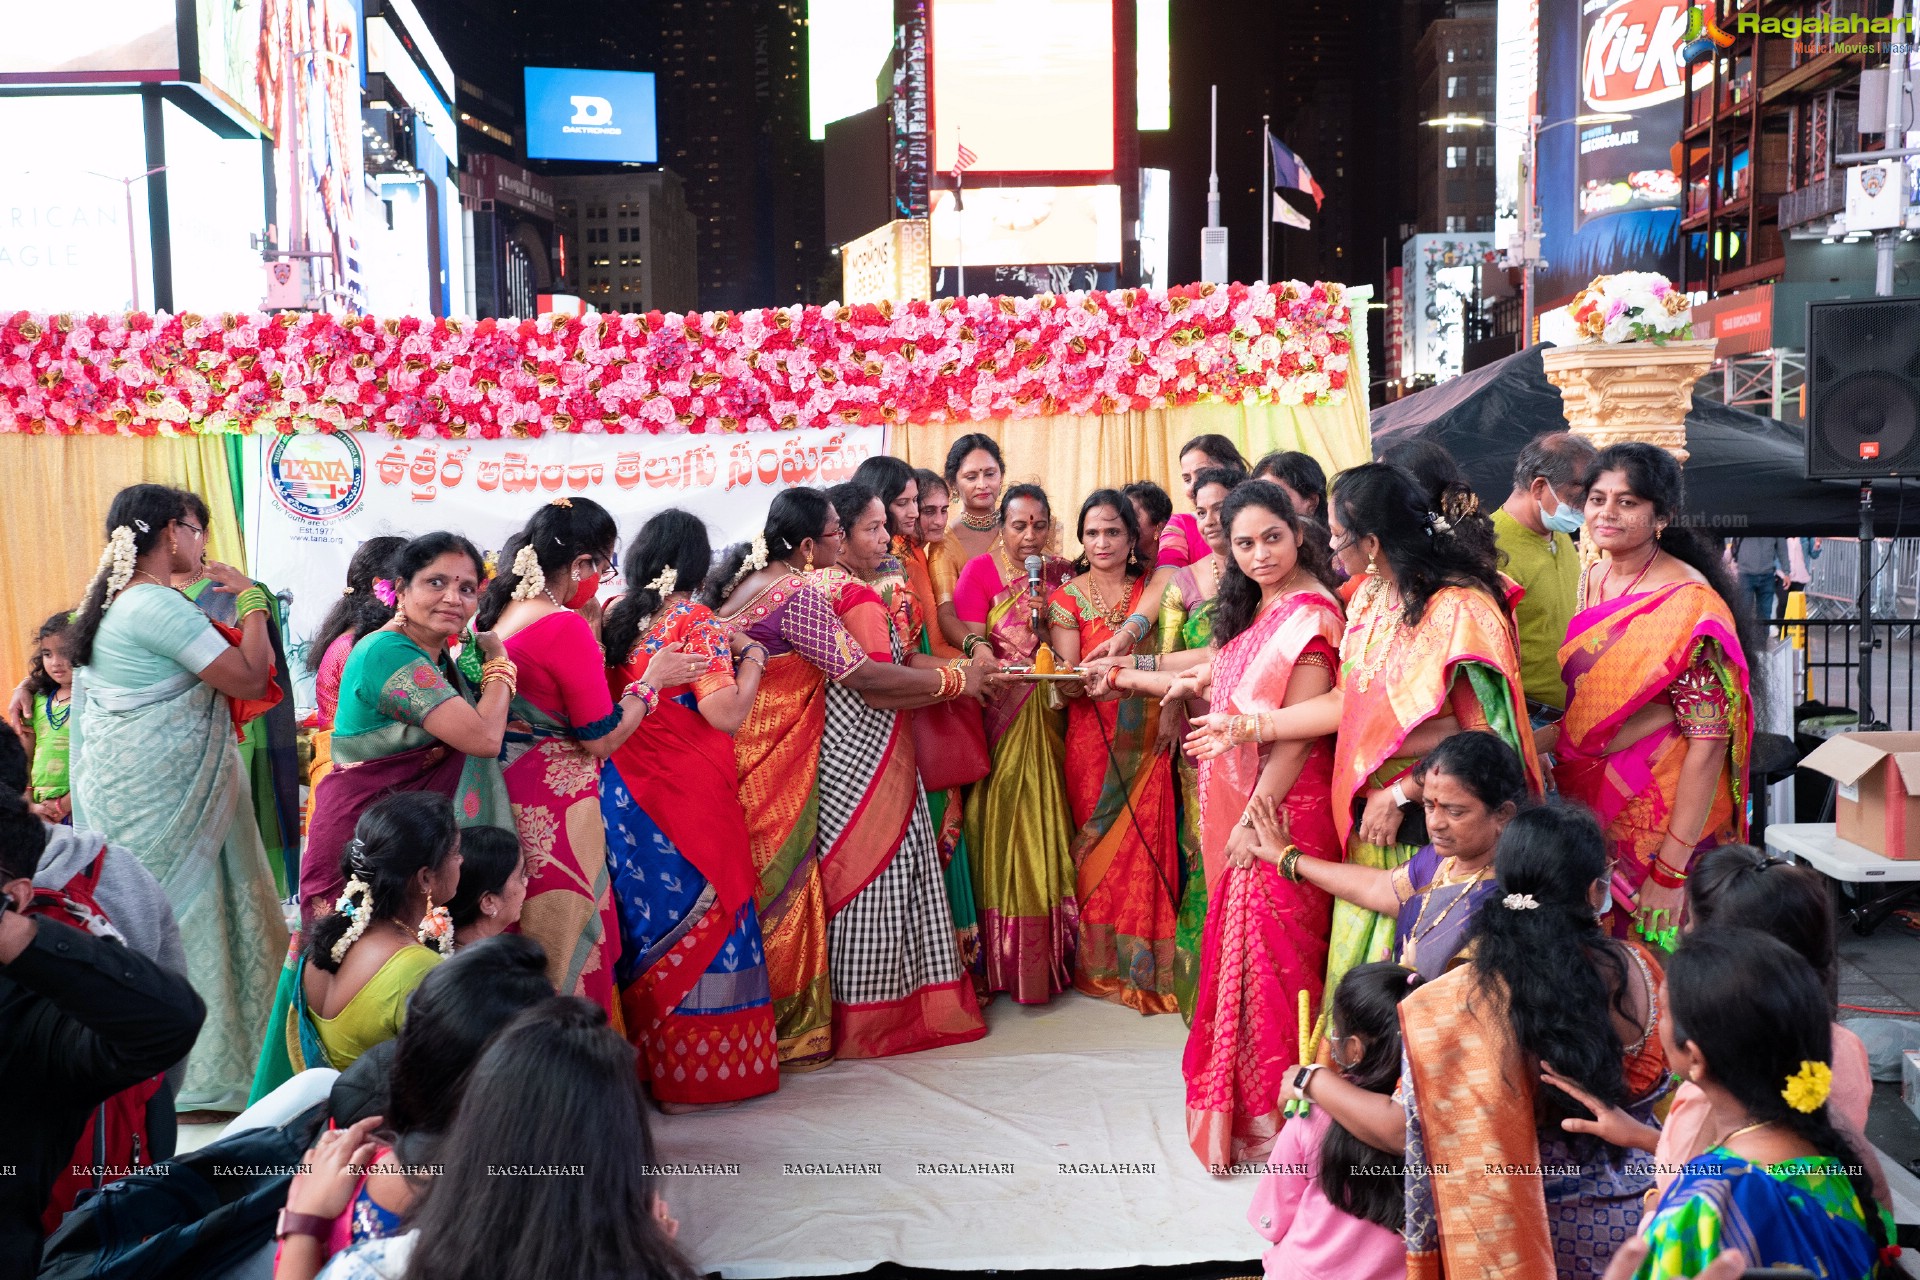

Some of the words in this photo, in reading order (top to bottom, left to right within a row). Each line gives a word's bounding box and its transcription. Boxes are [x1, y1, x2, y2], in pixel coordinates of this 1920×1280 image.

[562, 126, 622, 135] DAKTRONICS
[1, 205, 118, 228] RICAN
[281, 457, 353, 482] TANA
[271, 499, 283, 513] Our
[284, 510, 306, 524] Youth
[307, 519, 321, 527] are
[322, 518, 336, 526] Our
[338, 501, 365, 523] Heritage
[290, 534, 344, 545] www.tana.org
